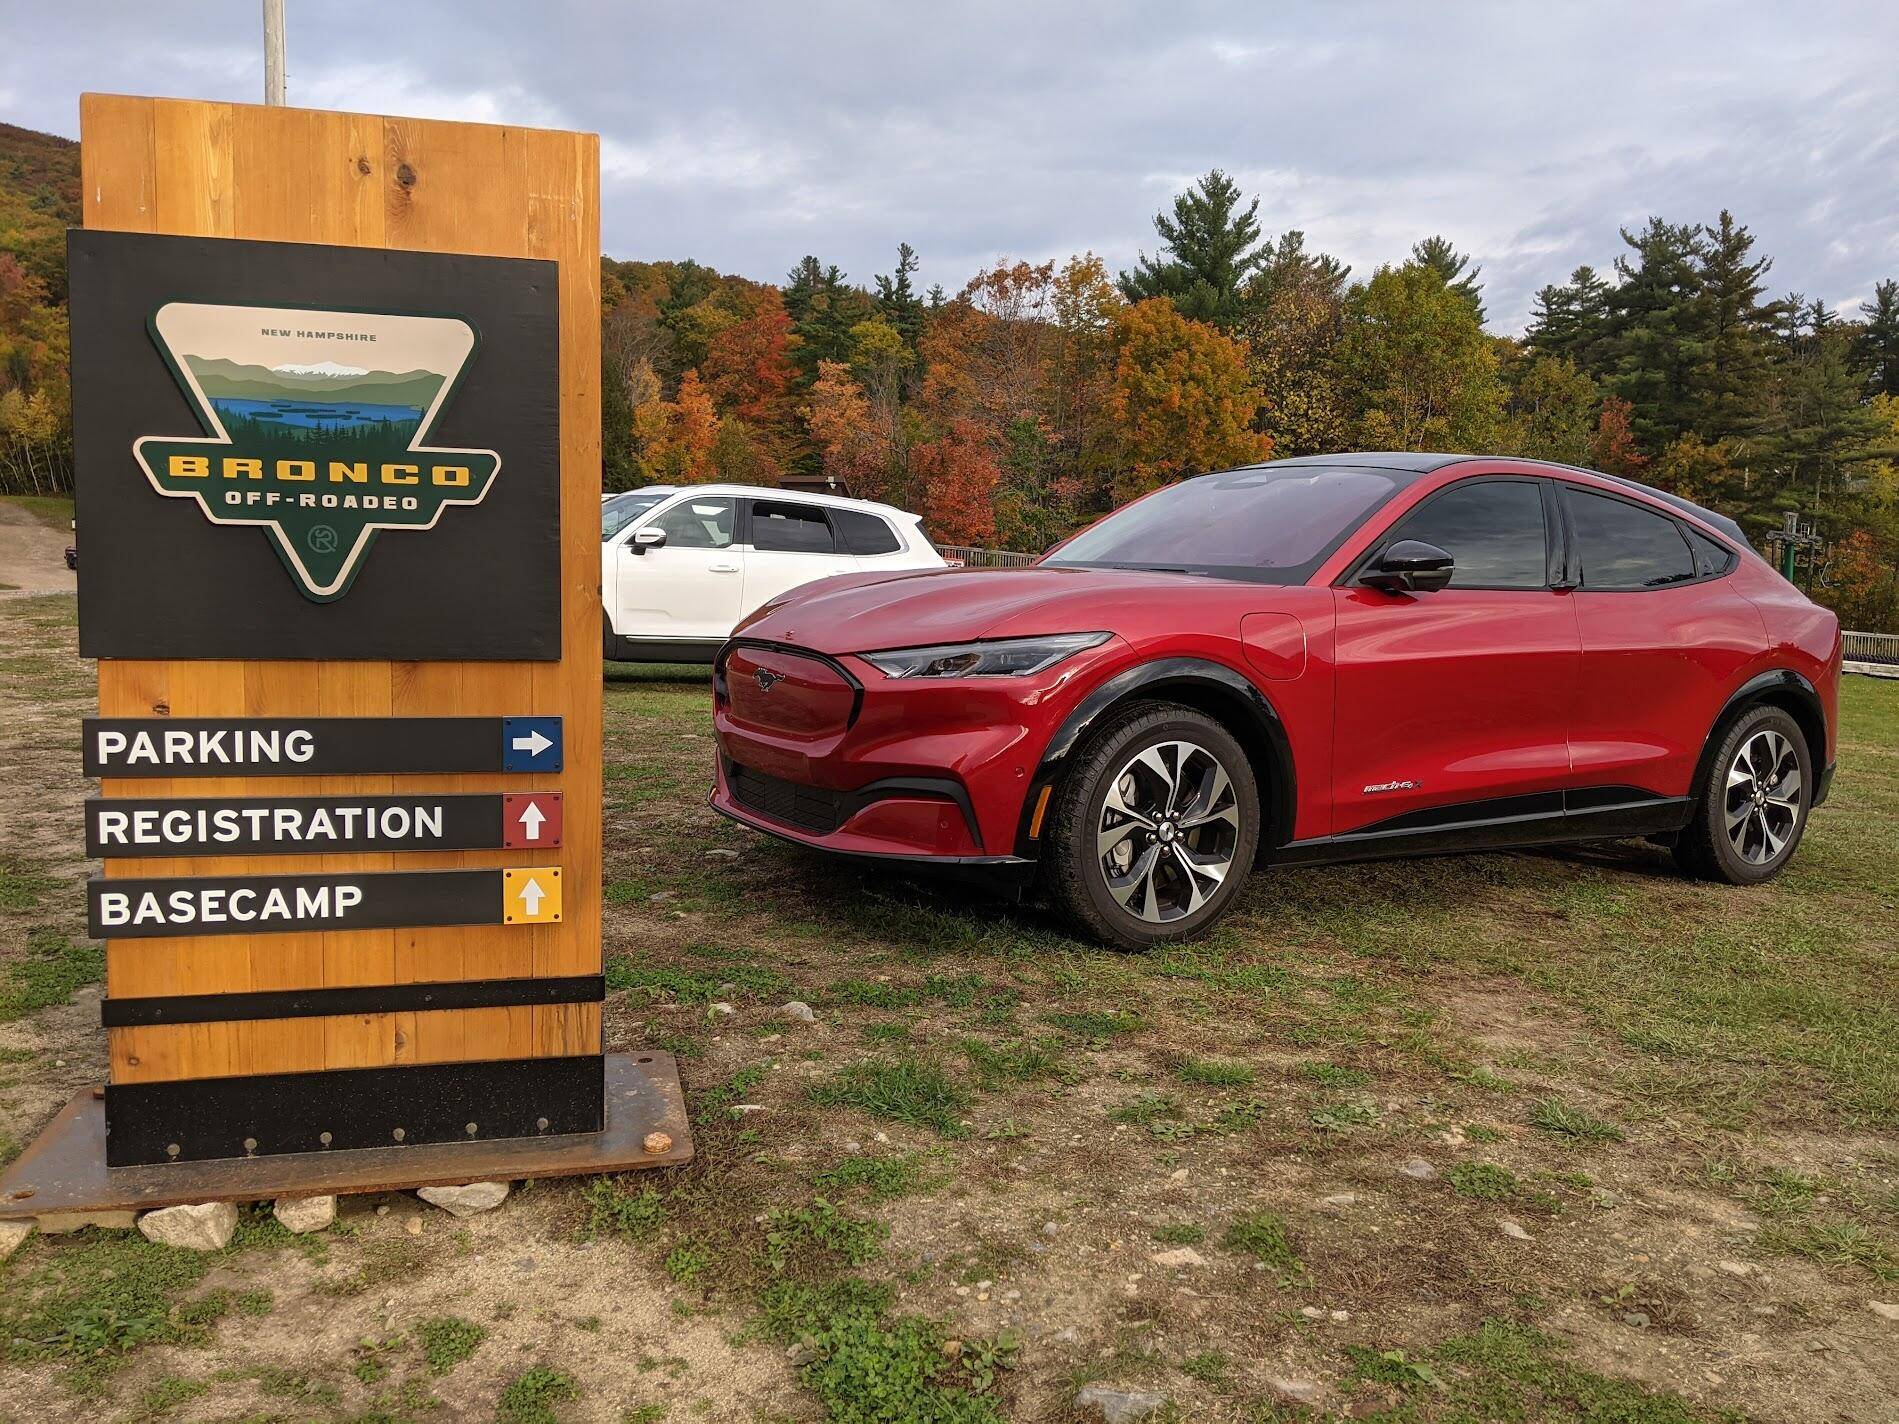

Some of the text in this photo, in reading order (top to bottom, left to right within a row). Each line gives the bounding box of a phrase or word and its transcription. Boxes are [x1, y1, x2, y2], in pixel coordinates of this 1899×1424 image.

[261, 328, 377, 342] NEW HAMPSHIRE
[168, 455, 470, 487] BRONCO
[225, 491, 418, 510] OFF-ROADEO
[97, 729, 315, 765] PARKING
[98, 806, 443, 845] REGISTRATION
[100, 885, 363, 926] BASECAMP
